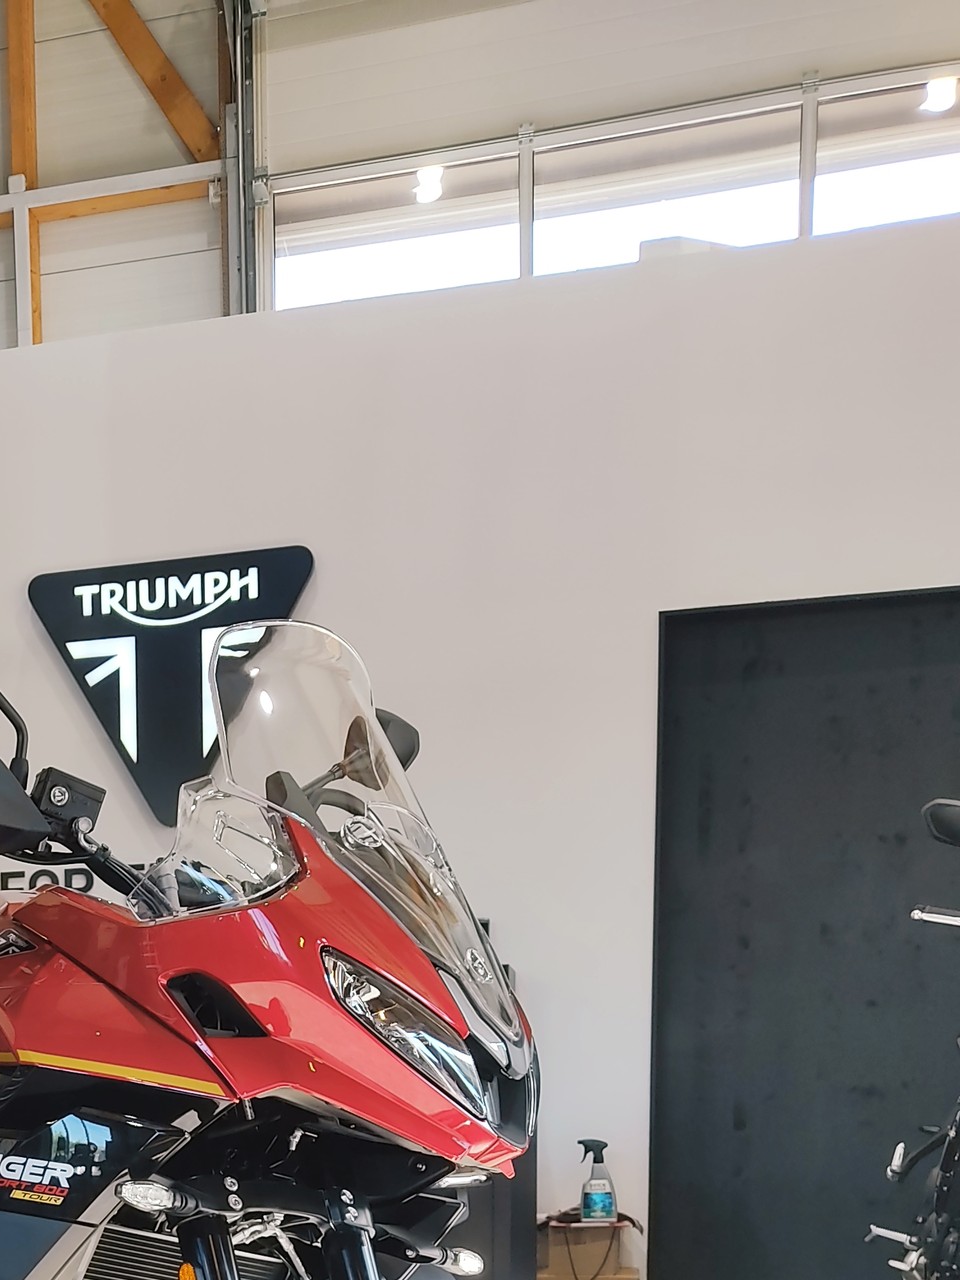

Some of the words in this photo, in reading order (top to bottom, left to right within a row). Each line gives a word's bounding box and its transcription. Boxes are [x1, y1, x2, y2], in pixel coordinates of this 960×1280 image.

[74, 566, 260, 626] TRIUMPH
[21, 1191, 60, 1203] TOUR
[32, 1183, 69, 1198] 800
